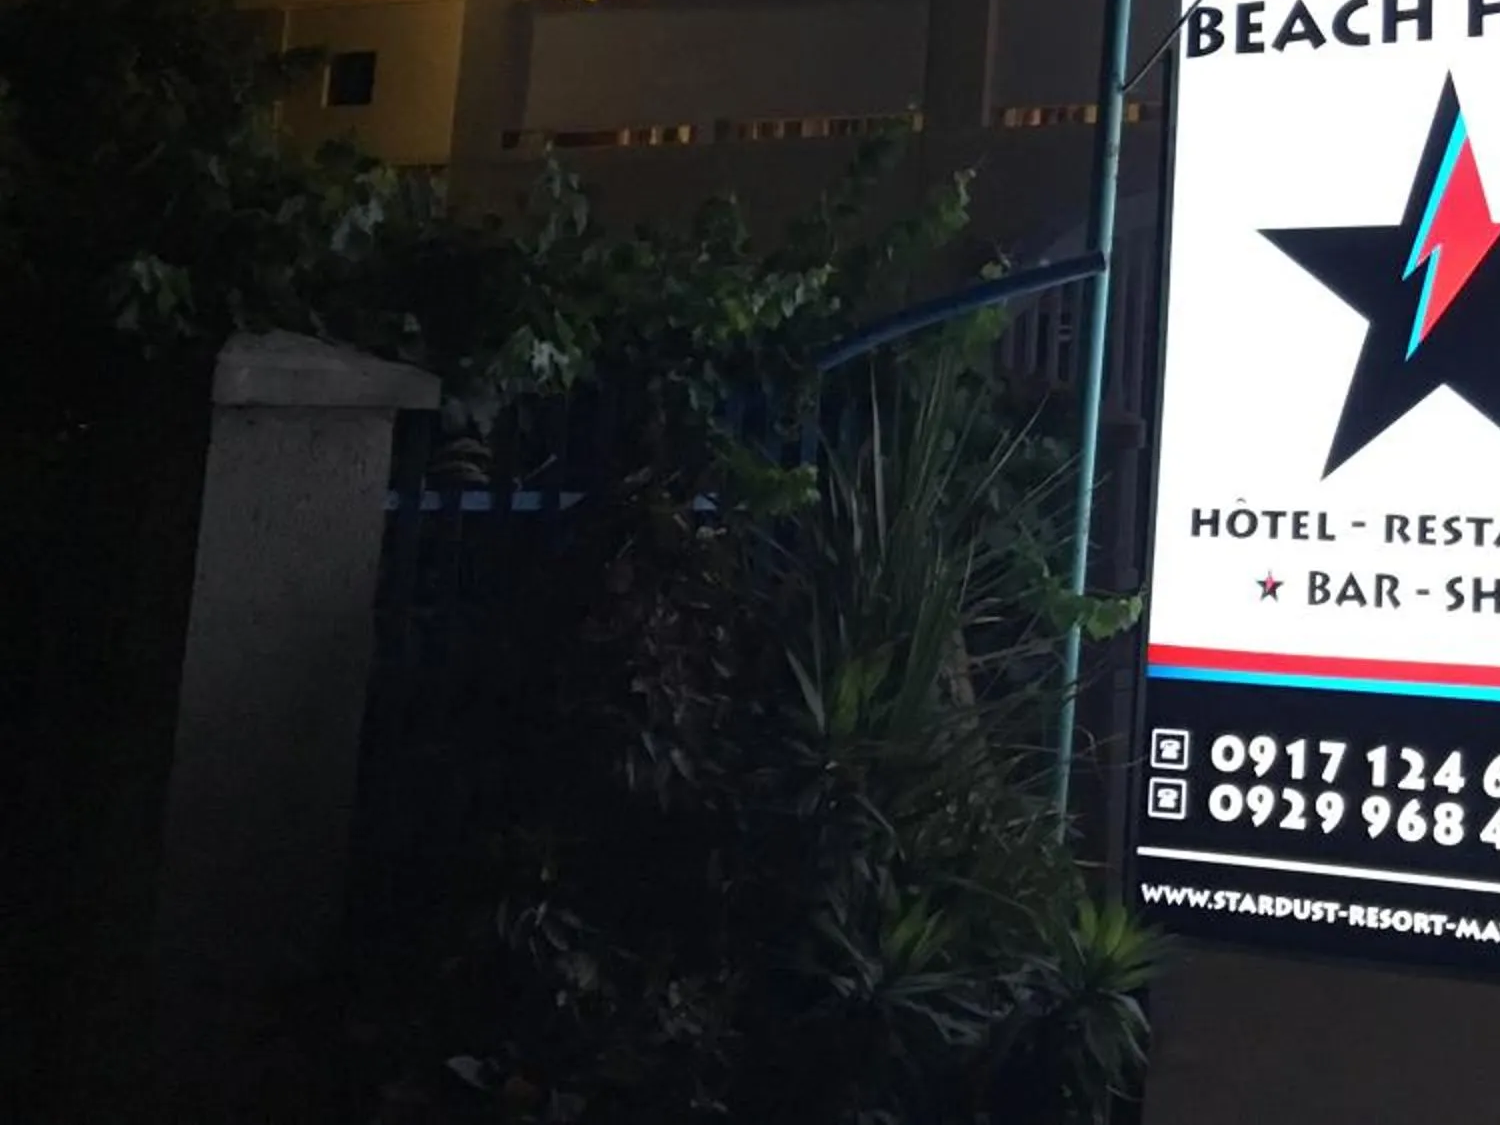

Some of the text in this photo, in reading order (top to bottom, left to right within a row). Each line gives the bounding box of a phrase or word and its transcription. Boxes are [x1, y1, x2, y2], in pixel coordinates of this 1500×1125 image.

[1191, 498, 1336, 542] HÔTEL
[1308, 570, 1401, 609] BAR
[1210, 734, 1348, 784] 0917
[1365, 745, 1467, 795] 124
[1207, 783, 1346, 834] 0929
[1360, 795, 1466, 846] 968
